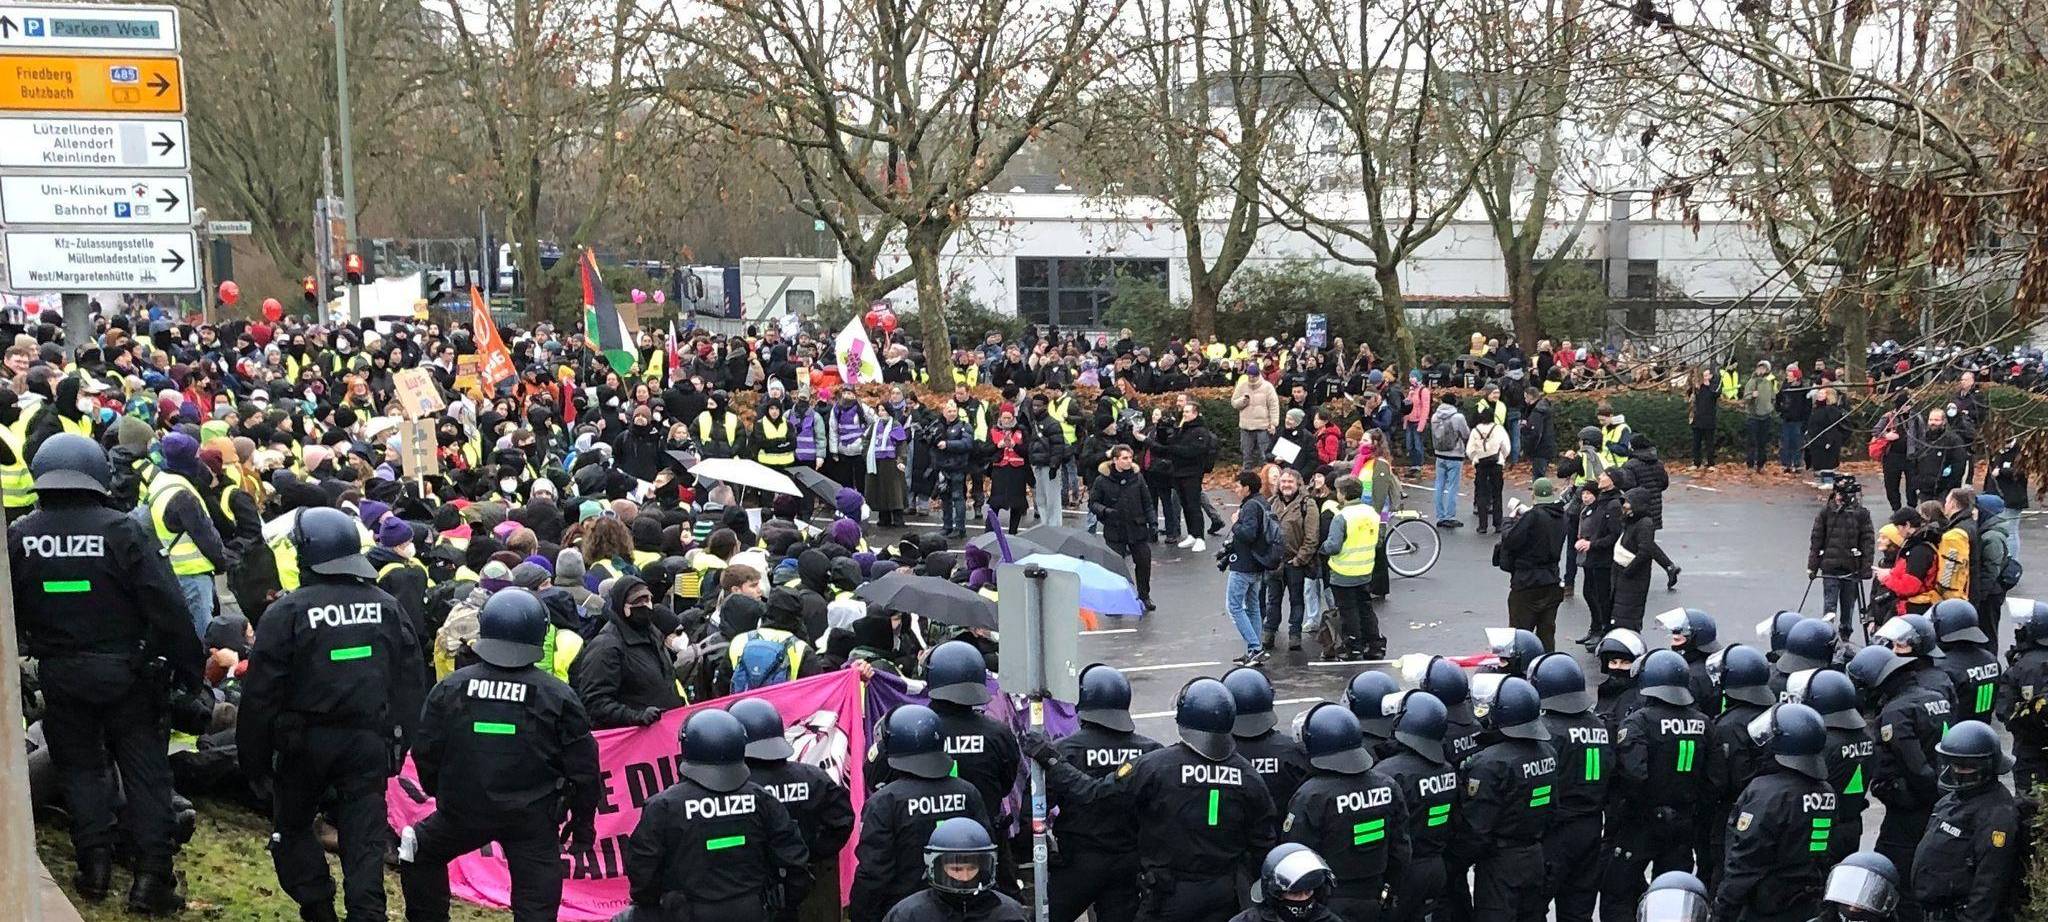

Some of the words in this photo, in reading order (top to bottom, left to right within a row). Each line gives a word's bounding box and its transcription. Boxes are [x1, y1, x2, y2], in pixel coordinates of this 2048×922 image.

[28, 20, 39, 34] P
[55, 21, 110, 34] Parken
[118, 23, 156, 36] West
[16, 67, 72, 83] Friedberg
[21, 86, 74, 99] Butzbach
[33, 123, 113, 135] Lützellinden
[54, 138, 113, 149] Allendorf
[43, 151, 116, 163] Kleinlinden
[41, 183, 127, 196] Uni-Klinikum
[55, 205, 108, 216] Bahnhof
[118, 204, 128, 216] P
[54, 238, 154, 251] Kfz-Zulassungsstelle
[68, 253, 156, 264] Müllumladestation
[29, 270, 134, 283] West/Margaretenhütte
[22, 535, 104, 558] POLIZEI
[307, 602, 382, 629] POLIZEI
[467, 679, 527, 702] POLIZEI
[944, 735, 984, 754] LIZEI
[1181, 764, 1242, 786] POLIZEI
[685, 794, 756, 820] POLIZEI
[908, 793, 966, 816] POLIZEI
